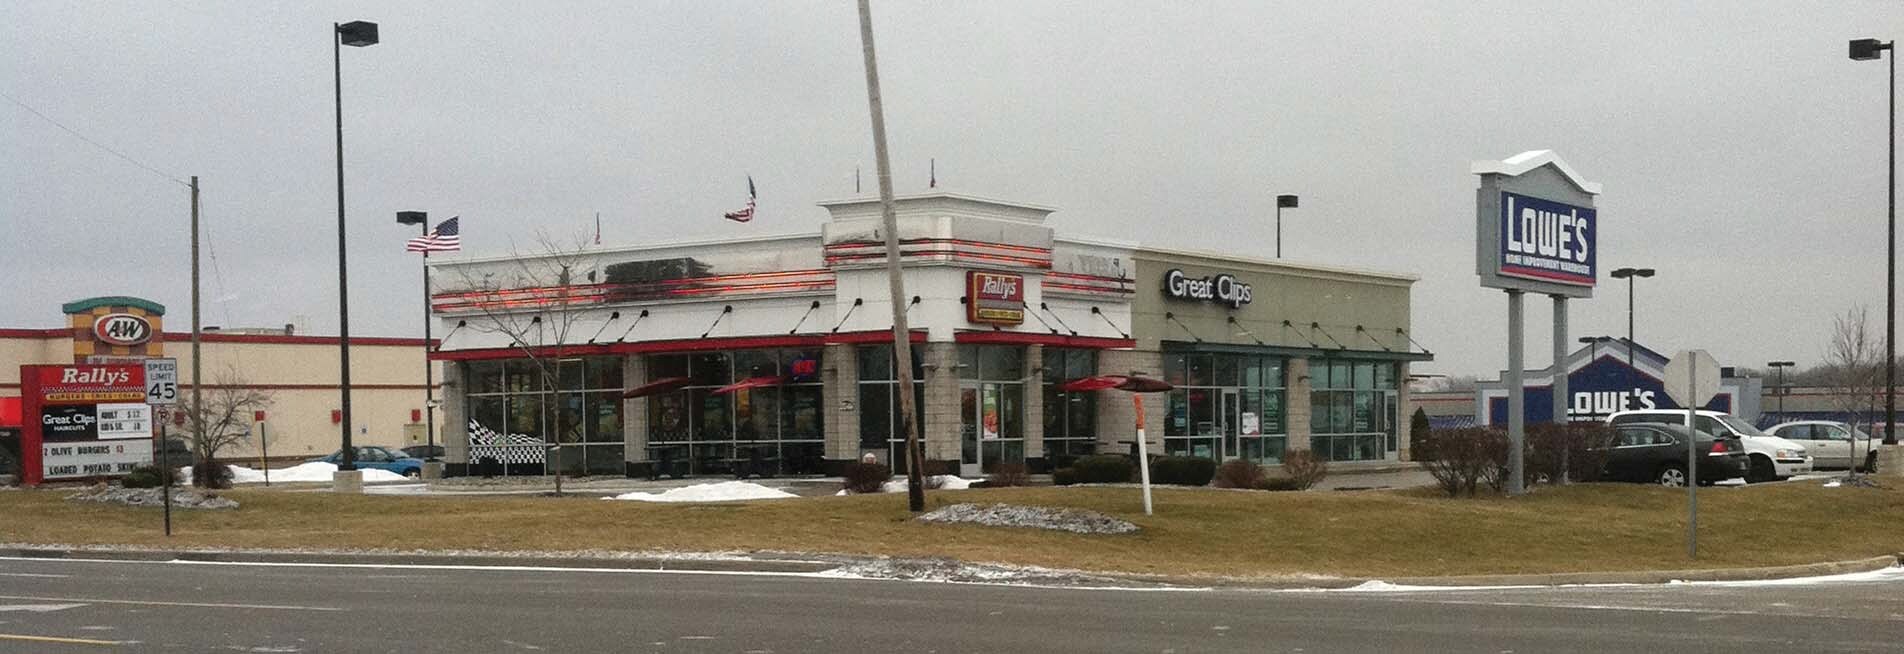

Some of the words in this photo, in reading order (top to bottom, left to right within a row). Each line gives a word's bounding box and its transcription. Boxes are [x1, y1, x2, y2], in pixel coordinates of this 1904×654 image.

[1507, 196, 1588, 263] LOWE'S
[1169, 270, 1214, 299] Great
[1217, 275, 1252, 308] Clips
[148, 363, 174, 371] SPEED
[61, 367, 130, 386] Rally's
[150, 372, 172, 380] LIMIT
[149, 382, 176, 399] 45
[1567, 387, 1656, 414] OWE'S
[43, 414, 71, 425] Great
[73, 413, 96, 426] Clips
[51, 447, 72, 456] OLIVE
[78, 445, 110, 455] BURGERS
[49, 465, 78, 475] LOADED
[84, 464, 111, 473] POTATO
